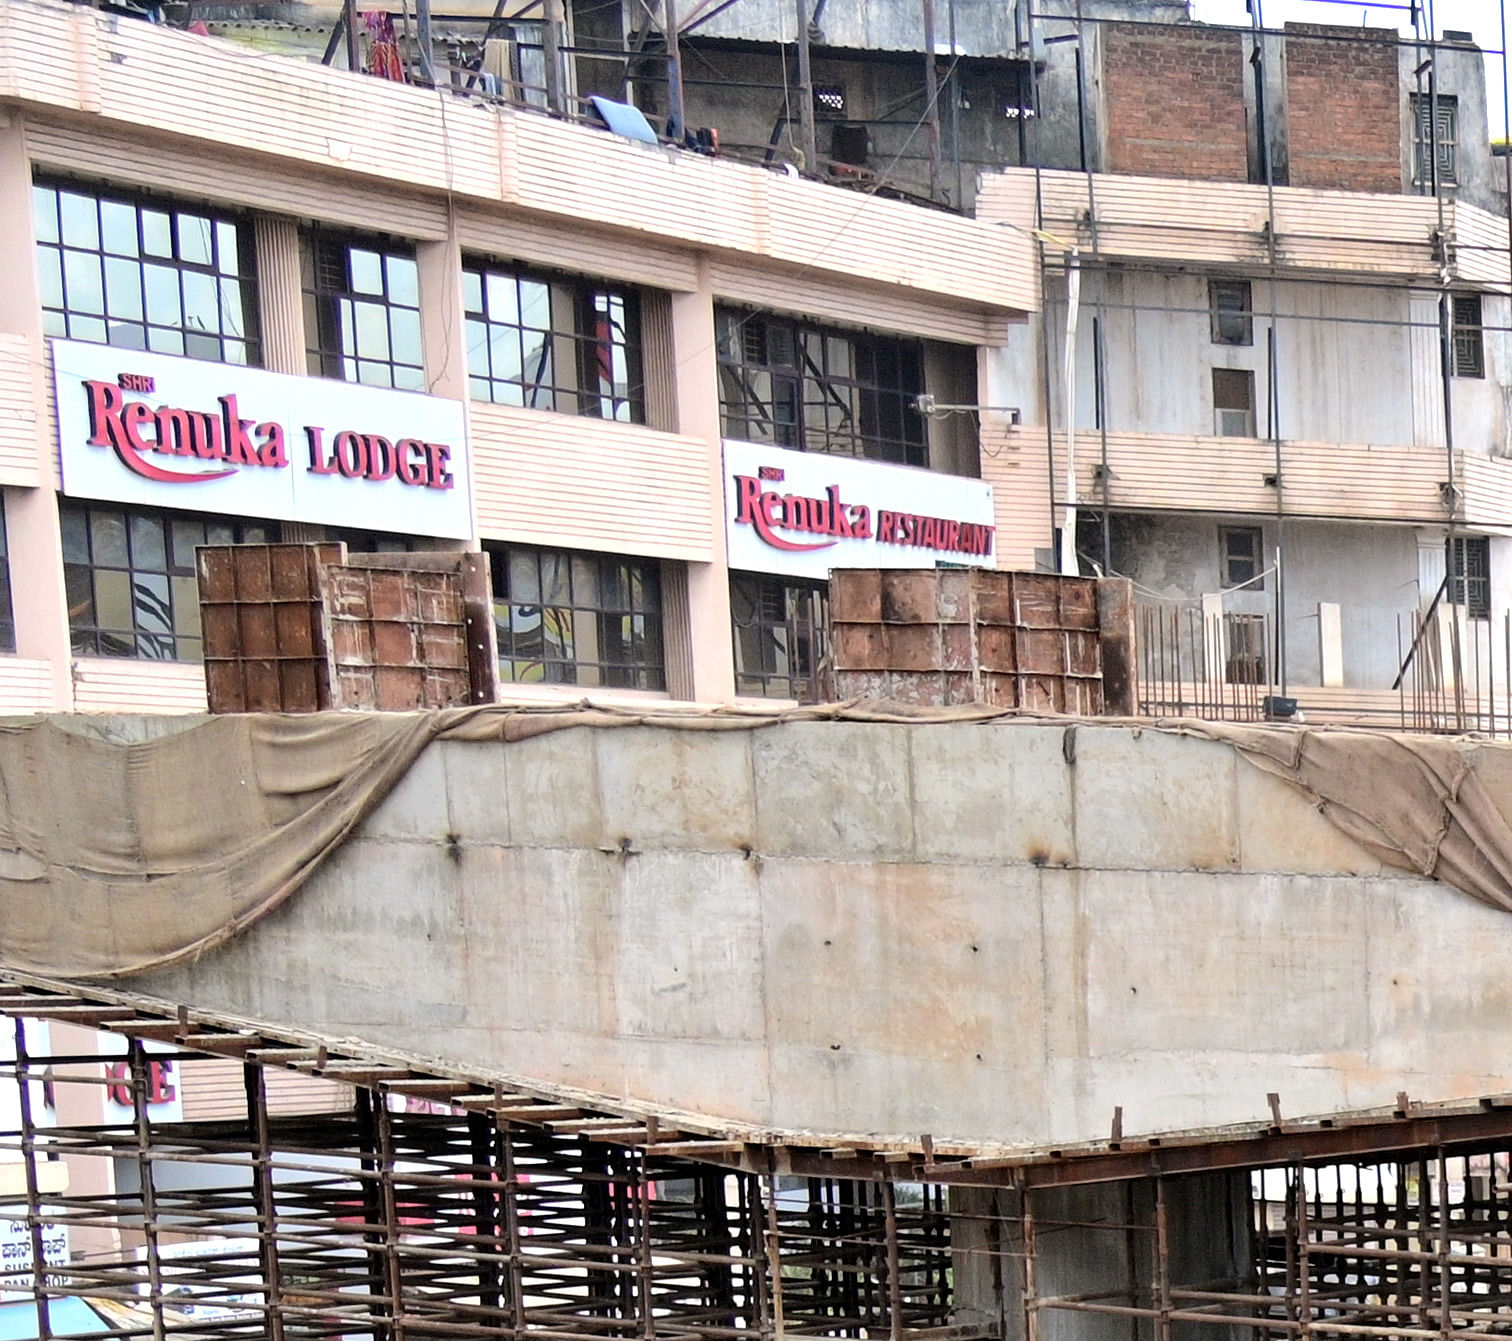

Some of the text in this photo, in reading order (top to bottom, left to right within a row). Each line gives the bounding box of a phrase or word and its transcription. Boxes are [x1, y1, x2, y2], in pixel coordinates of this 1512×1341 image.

[82, 380, 453, 489] Renuka LODGE
[733, 474, 996, 556] Renuka RESTAURANT
